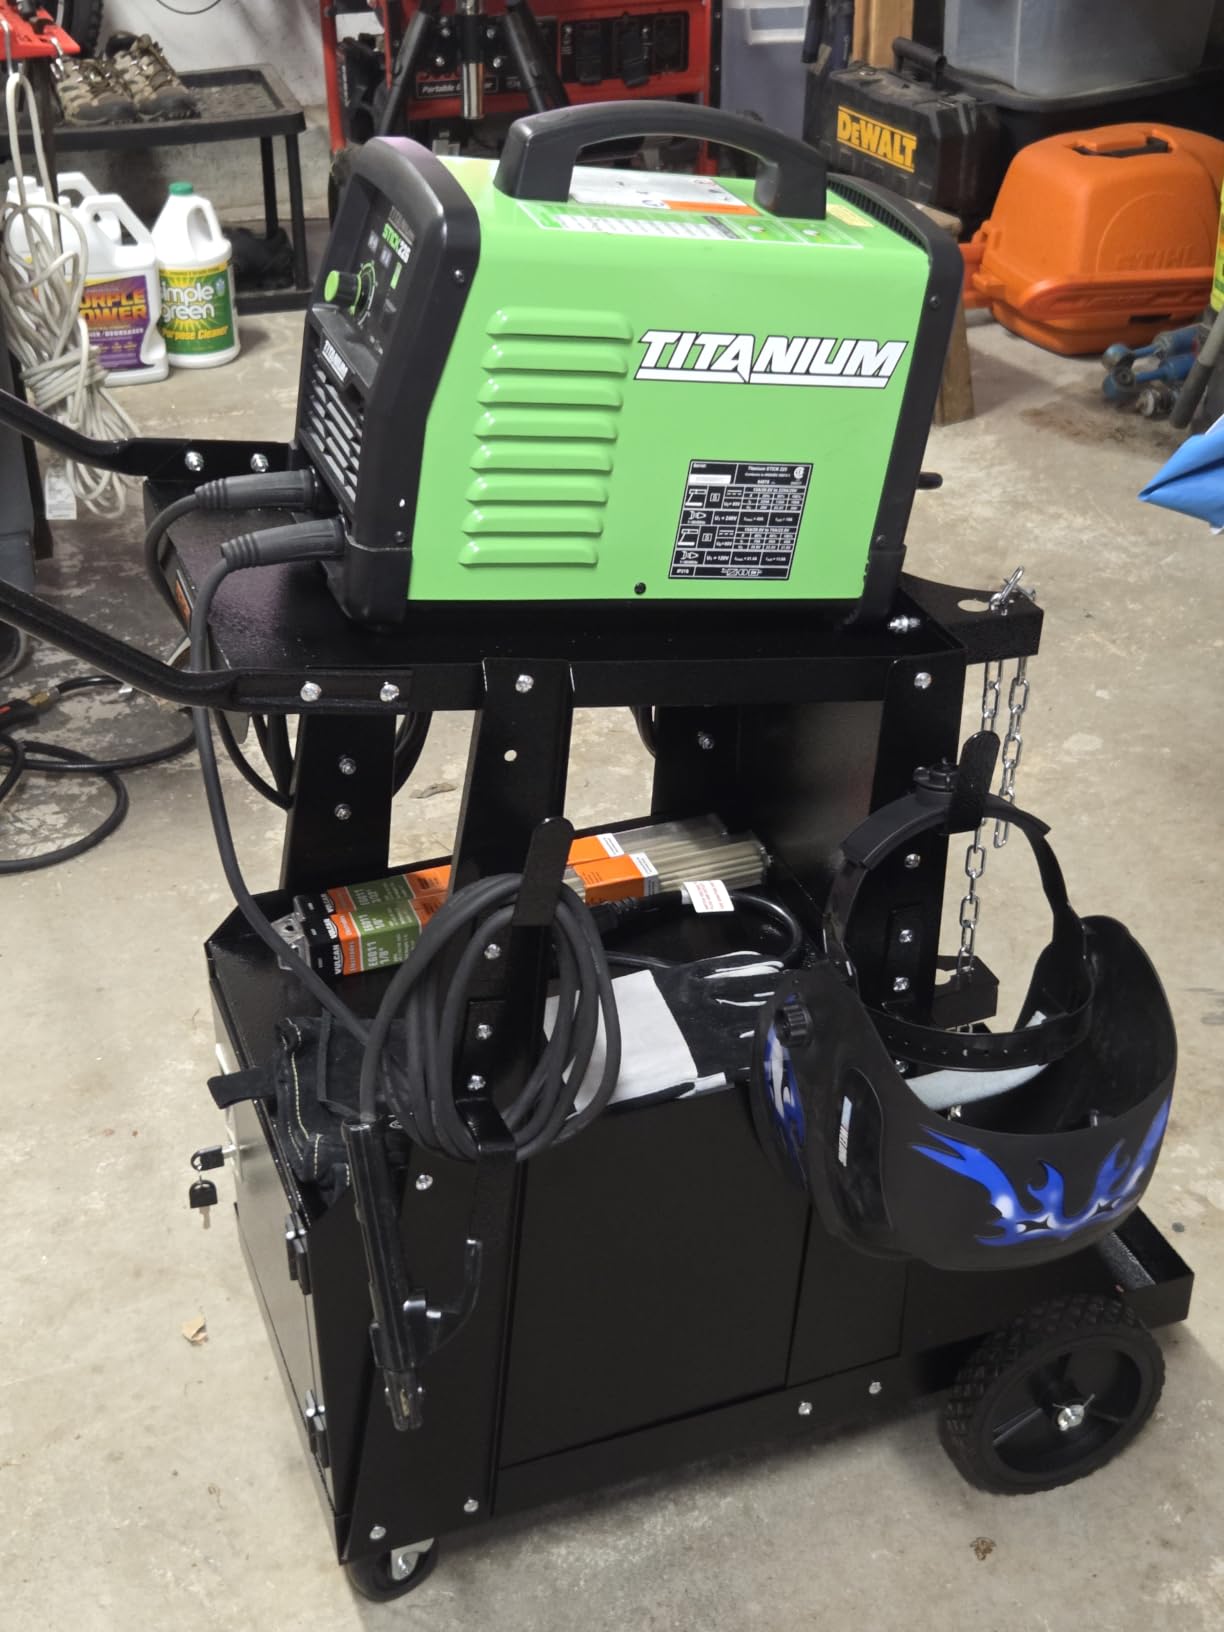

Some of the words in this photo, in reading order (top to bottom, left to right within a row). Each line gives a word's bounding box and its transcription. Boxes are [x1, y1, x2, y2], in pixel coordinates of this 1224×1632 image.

[79, 288, 145, 308] URPLE
[160, 280, 215, 306] imple
[79, 304, 147, 322] OWER
[160, 303, 215, 323] green
[634, 329, 910, 389] TITANIUM
[323, 918, 338, 939] VULCAN
[332, 944, 342, 975] VULCAN
[366, 941, 378, 967] E6011
